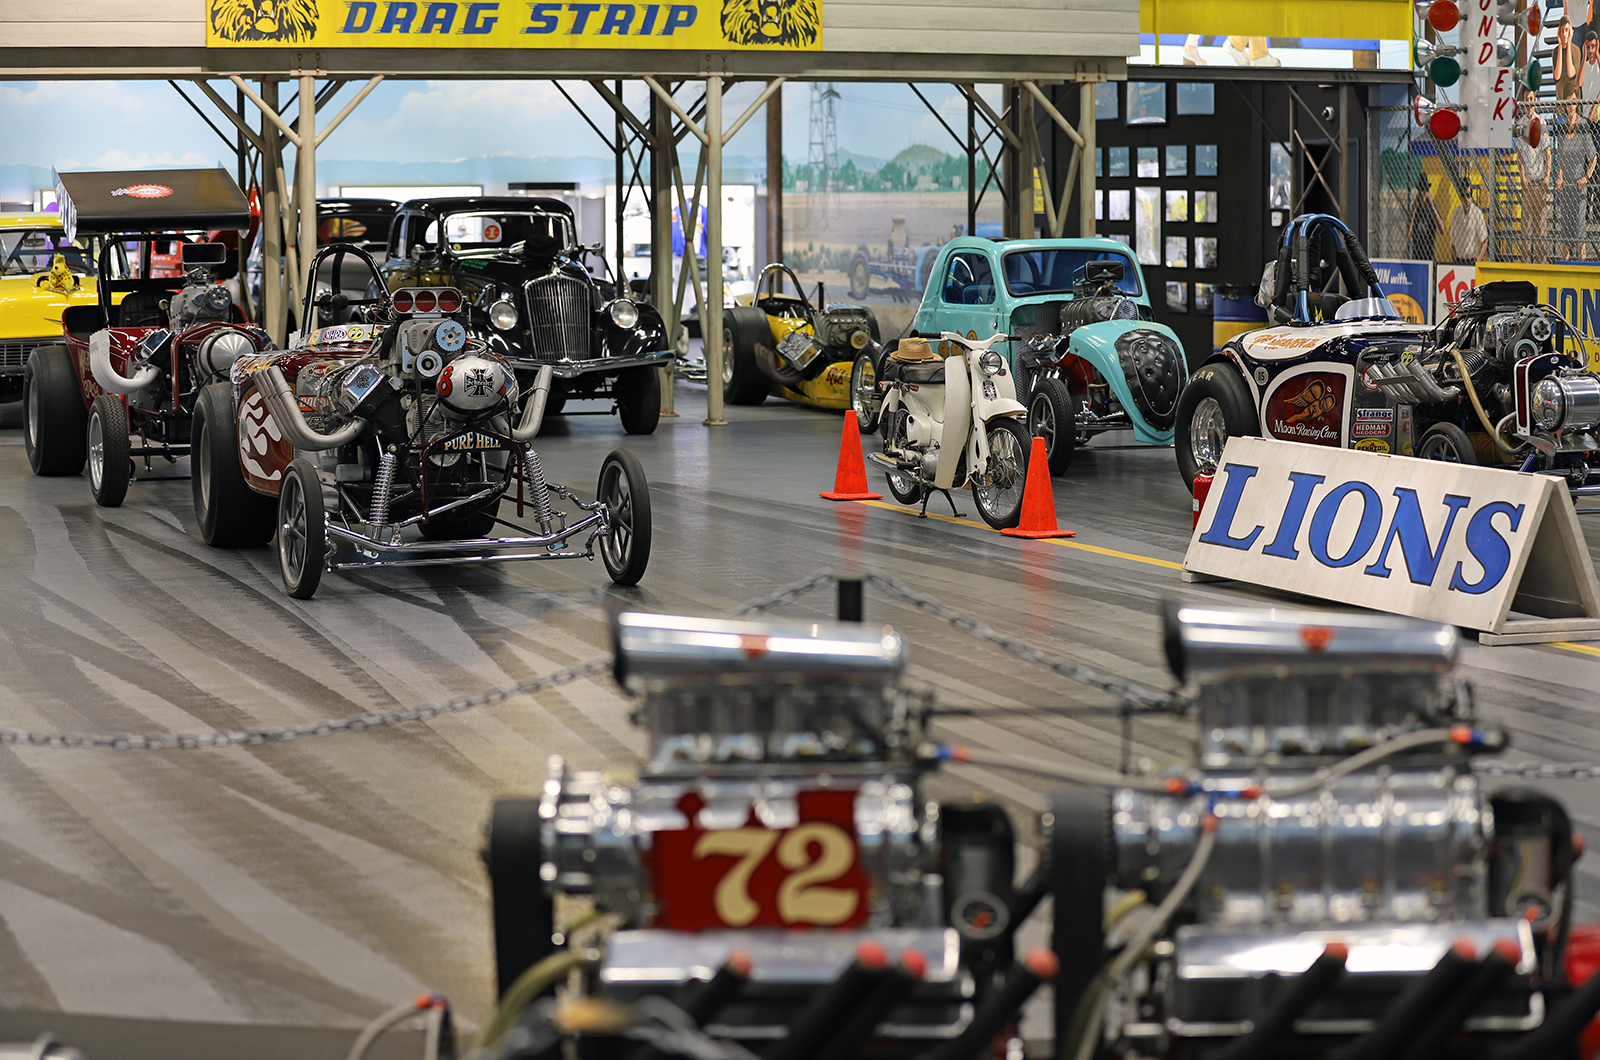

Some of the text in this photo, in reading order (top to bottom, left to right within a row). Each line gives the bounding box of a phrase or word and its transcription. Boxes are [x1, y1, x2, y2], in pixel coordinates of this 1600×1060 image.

[336, 1, 698, 36] DRAG STRIP
[438, 366, 453, 398] 8
[1357, 409, 1392, 417] Strange
[444, 431, 501, 450] PURE HELL
[1274, 419, 1338, 440] Moon Racing Cam
[1199, 462, 1526, 595] LIONS
[692, 822, 860, 927] 72
